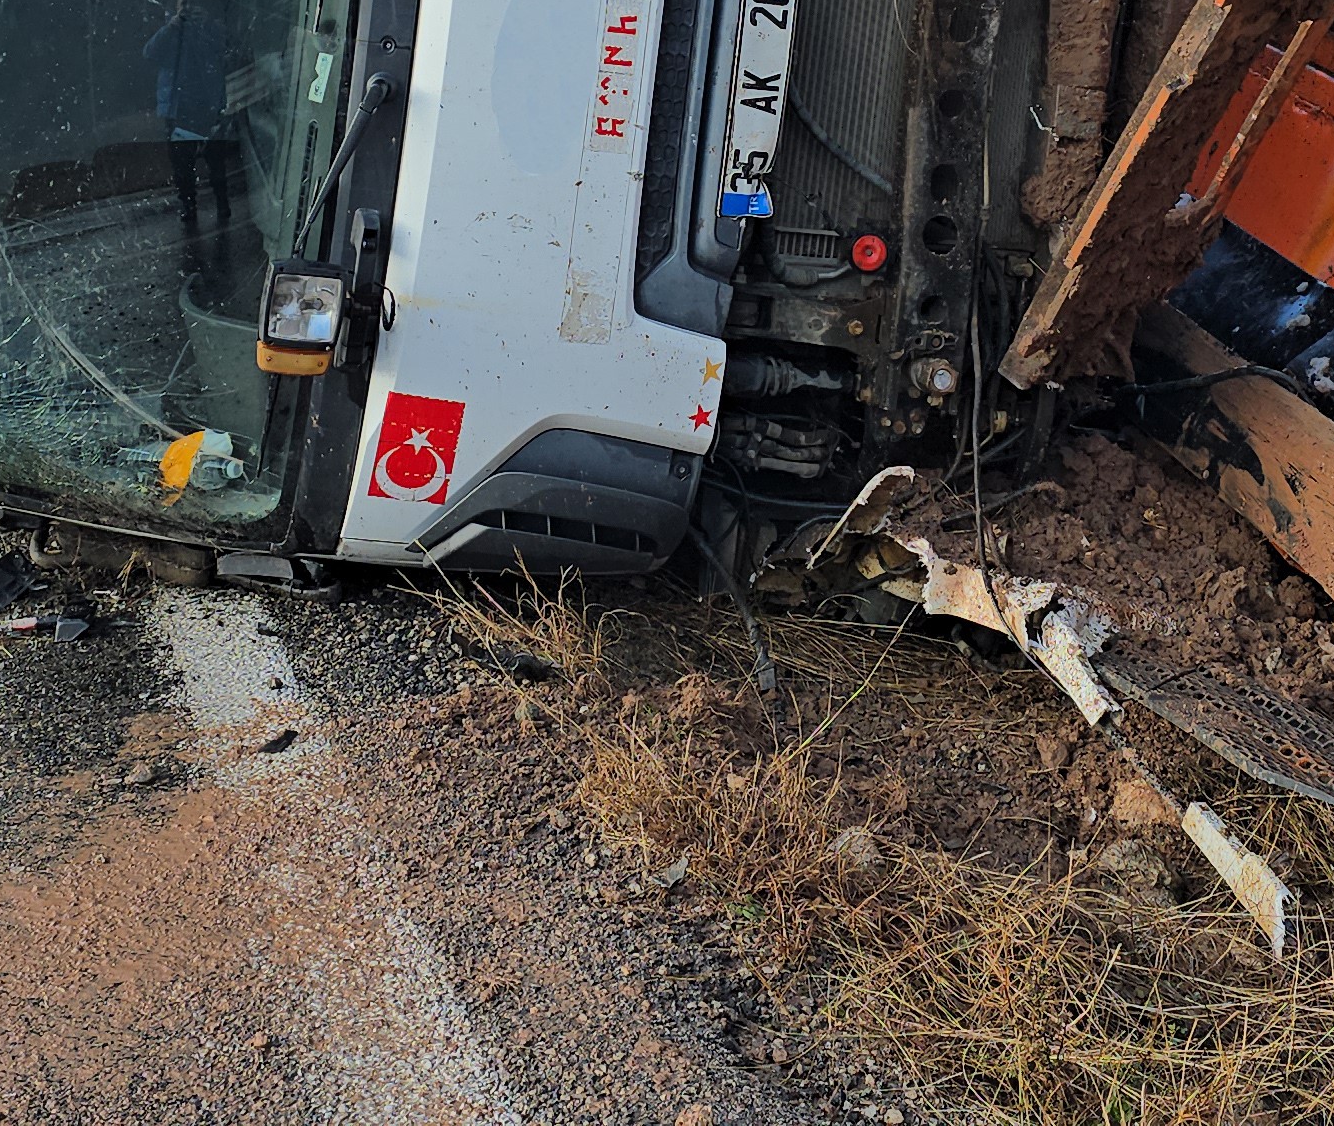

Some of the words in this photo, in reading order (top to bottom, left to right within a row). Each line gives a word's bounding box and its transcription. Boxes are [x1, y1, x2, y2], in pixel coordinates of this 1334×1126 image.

[740, 70, 782, 115] AK
[730, 149, 768, 193] 35
[748, 196, 760, 214] TR
